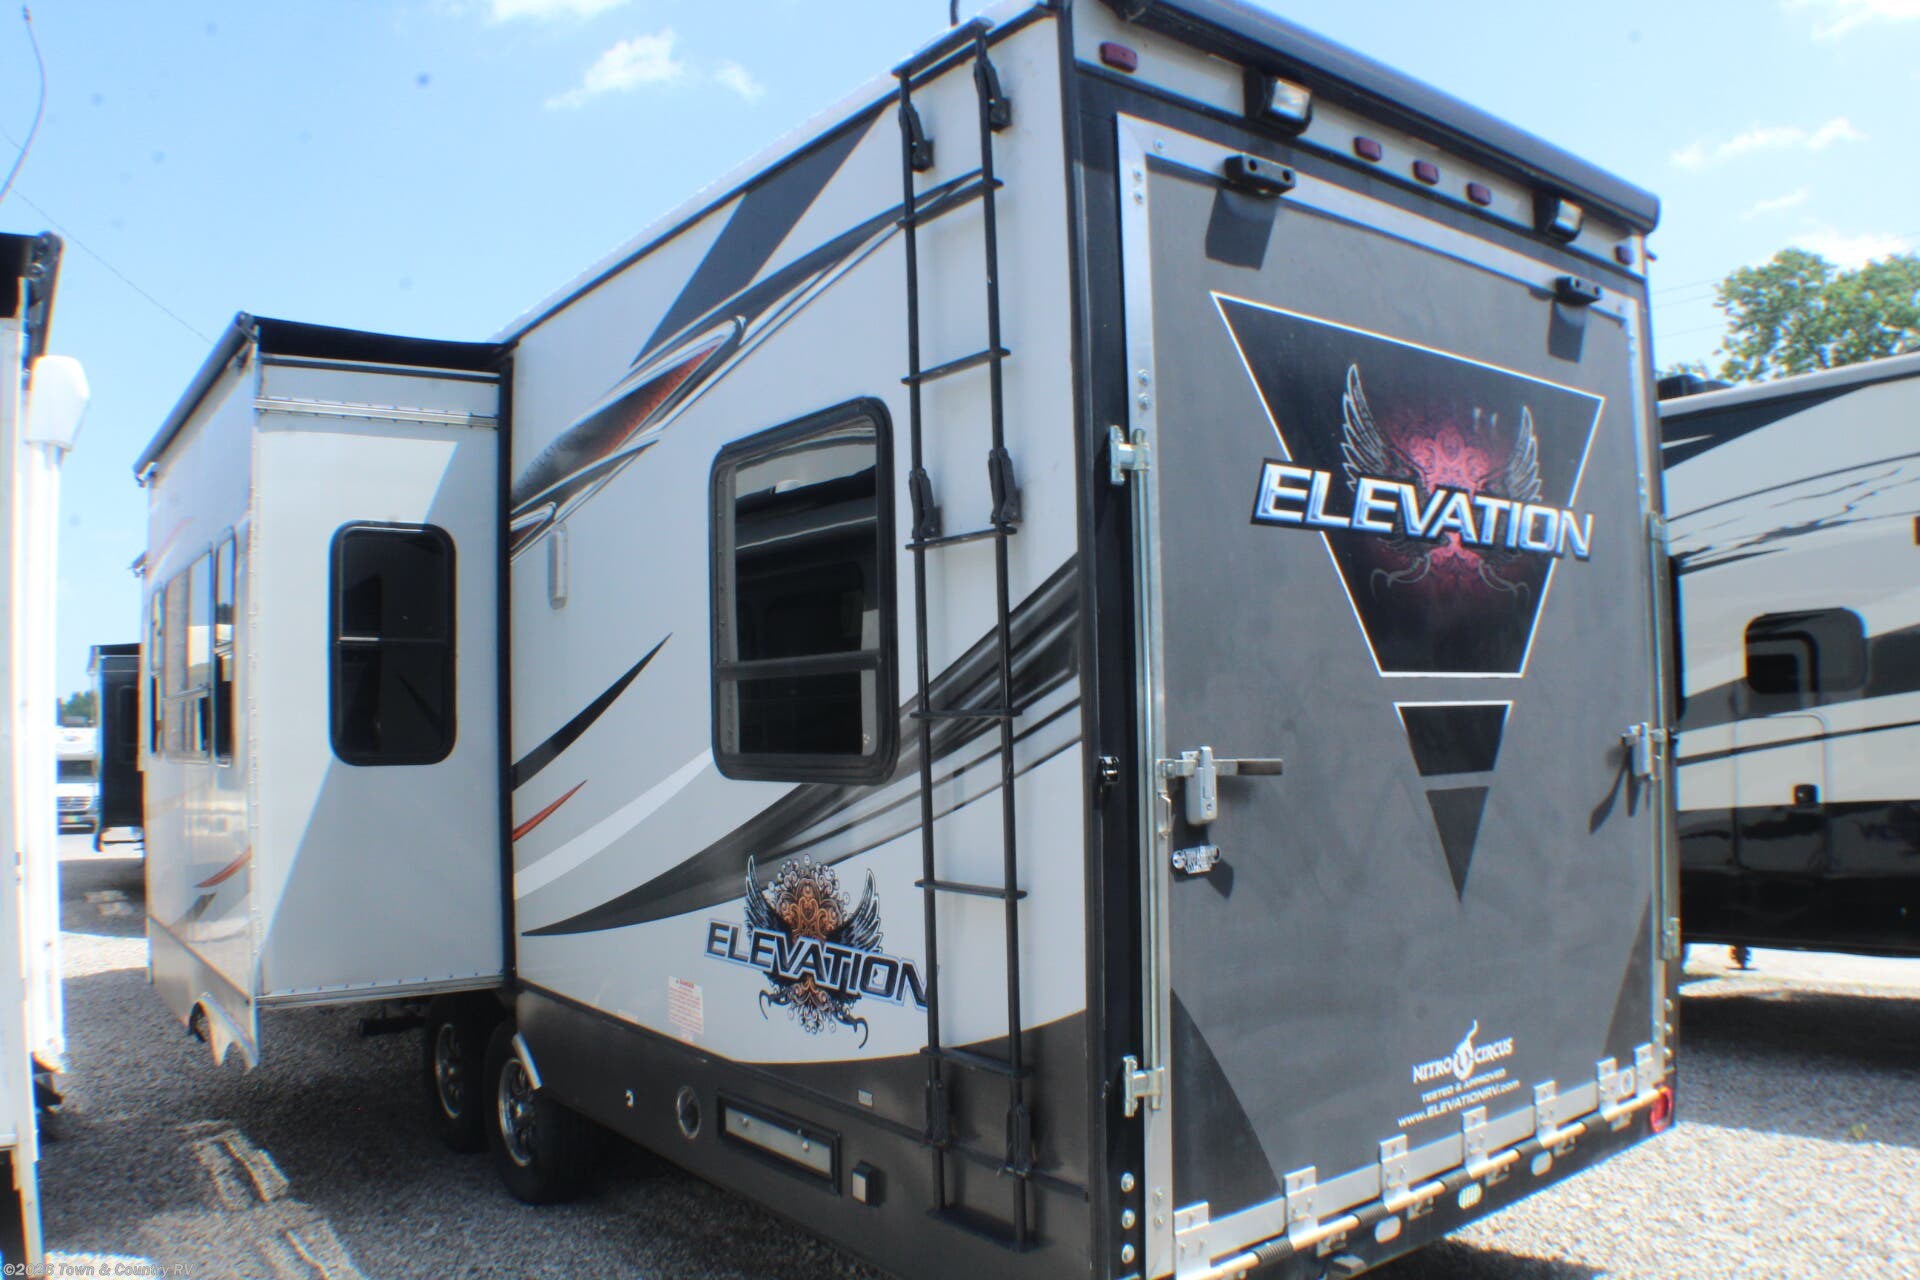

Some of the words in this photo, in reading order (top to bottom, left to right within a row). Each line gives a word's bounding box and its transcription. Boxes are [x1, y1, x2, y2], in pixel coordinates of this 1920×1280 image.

[1254, 462, 1595, 559] ELEVATION
[1412, 1056, 1453, 1084] NITRO
[1474, 1037, 1514, 1064] CIRCUS
